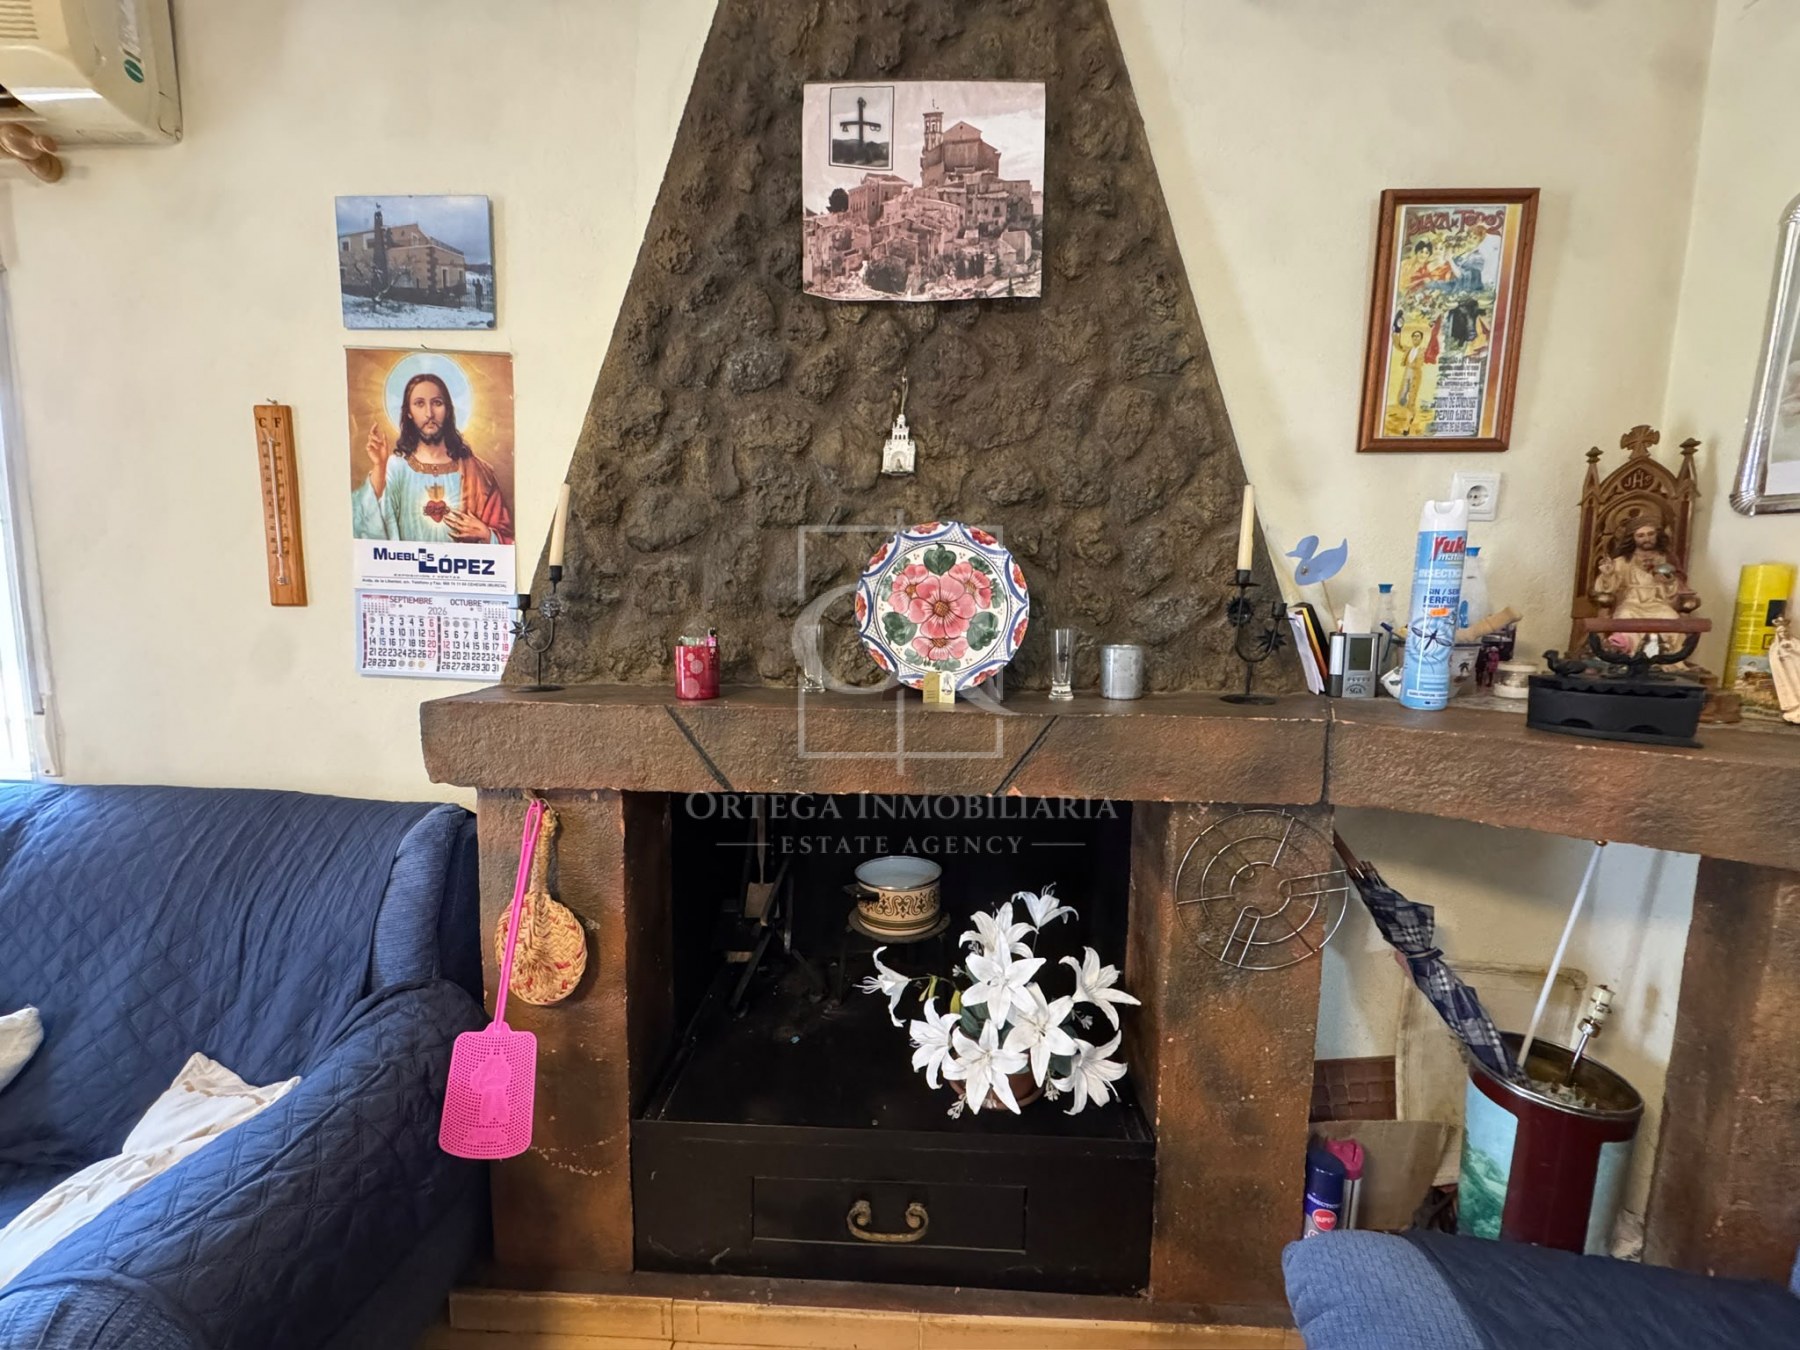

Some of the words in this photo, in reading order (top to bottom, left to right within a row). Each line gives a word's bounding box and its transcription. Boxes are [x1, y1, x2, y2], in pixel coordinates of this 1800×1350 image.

[389, 596, 433, 604] SEPTIEMBRE
[450, 599, 482, 607] OCTUBRE
[389, 617, 394, 625] 2
[400, 617, 404, 625] 3
[410, 618, 414, 626] 4
[429, 619, 434, 627] 6
[474, 621, 478, 629] 1
[484, 622, 488, 630] 2
[494, 622, 498, 630] 3
[370, 627, 374, 635] 7
[380, 627, 384, 635] 8
[399, 628, 405, 636] 10
[419, 629, 425, 637] 12
[454, 631, 459, 639] 6
[464, 631, 468, 639] 7
[503, 633, 508, 641] 11
[369, 637, 376, 645] 14
[389, 638, 396, 646] 16
[409, 639, 415, 647] 18
[428, 640, 436, 648] 20
[443, 641, 450, 649] 12
[473, 642, 479, 650] 15
[369, 648, 376, 656] 21
[378, 648, 387, 656] 22
[388, 649, 397, 657] 23
[398, 649, 406, 657] 24
[418, 650, 426, 658] 26
[463, 652, 470, 660] 21
[482, 653, 490, 661] 23
[387, 659, 396, 667] 30
[471, 663, 480, 671] 29
[492, 664, 499, 672] 31
